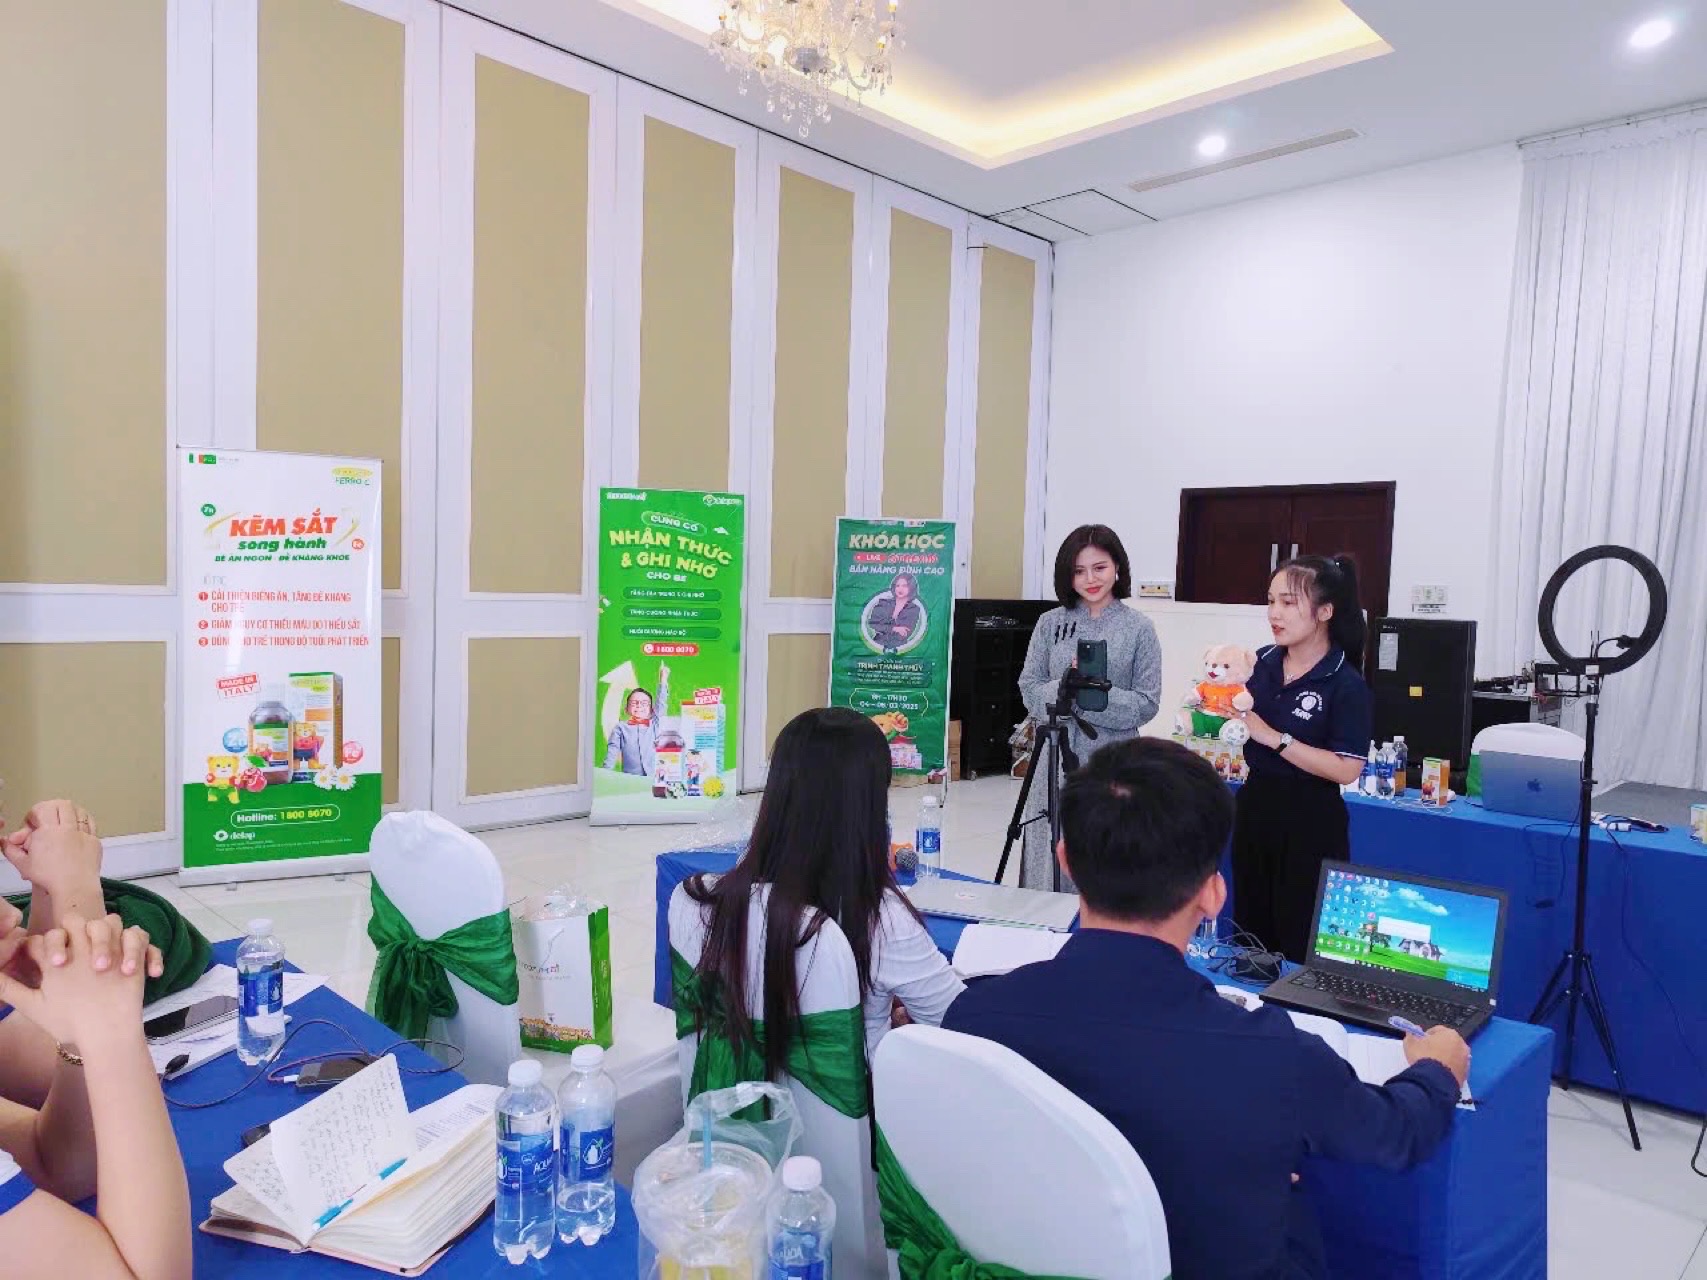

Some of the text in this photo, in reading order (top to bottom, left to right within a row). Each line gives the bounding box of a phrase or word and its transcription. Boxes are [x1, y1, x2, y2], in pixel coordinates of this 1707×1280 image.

[609, 528, 671, 549] NHẬN
[848, 531, 946, 552] KHÓA HỌC
[237, 539, 280, 552] song
[621, 552, 632, 568] &
[636, 551, 671, 568] GHI
[646, 571, 671, 581] CHO
[923, 567, 945, 575] CAO
[219, 676, 256, 688] MADE IN
[223, 684, 255, 697] ITALY
[236, 814, 277, 823] Hotline:
